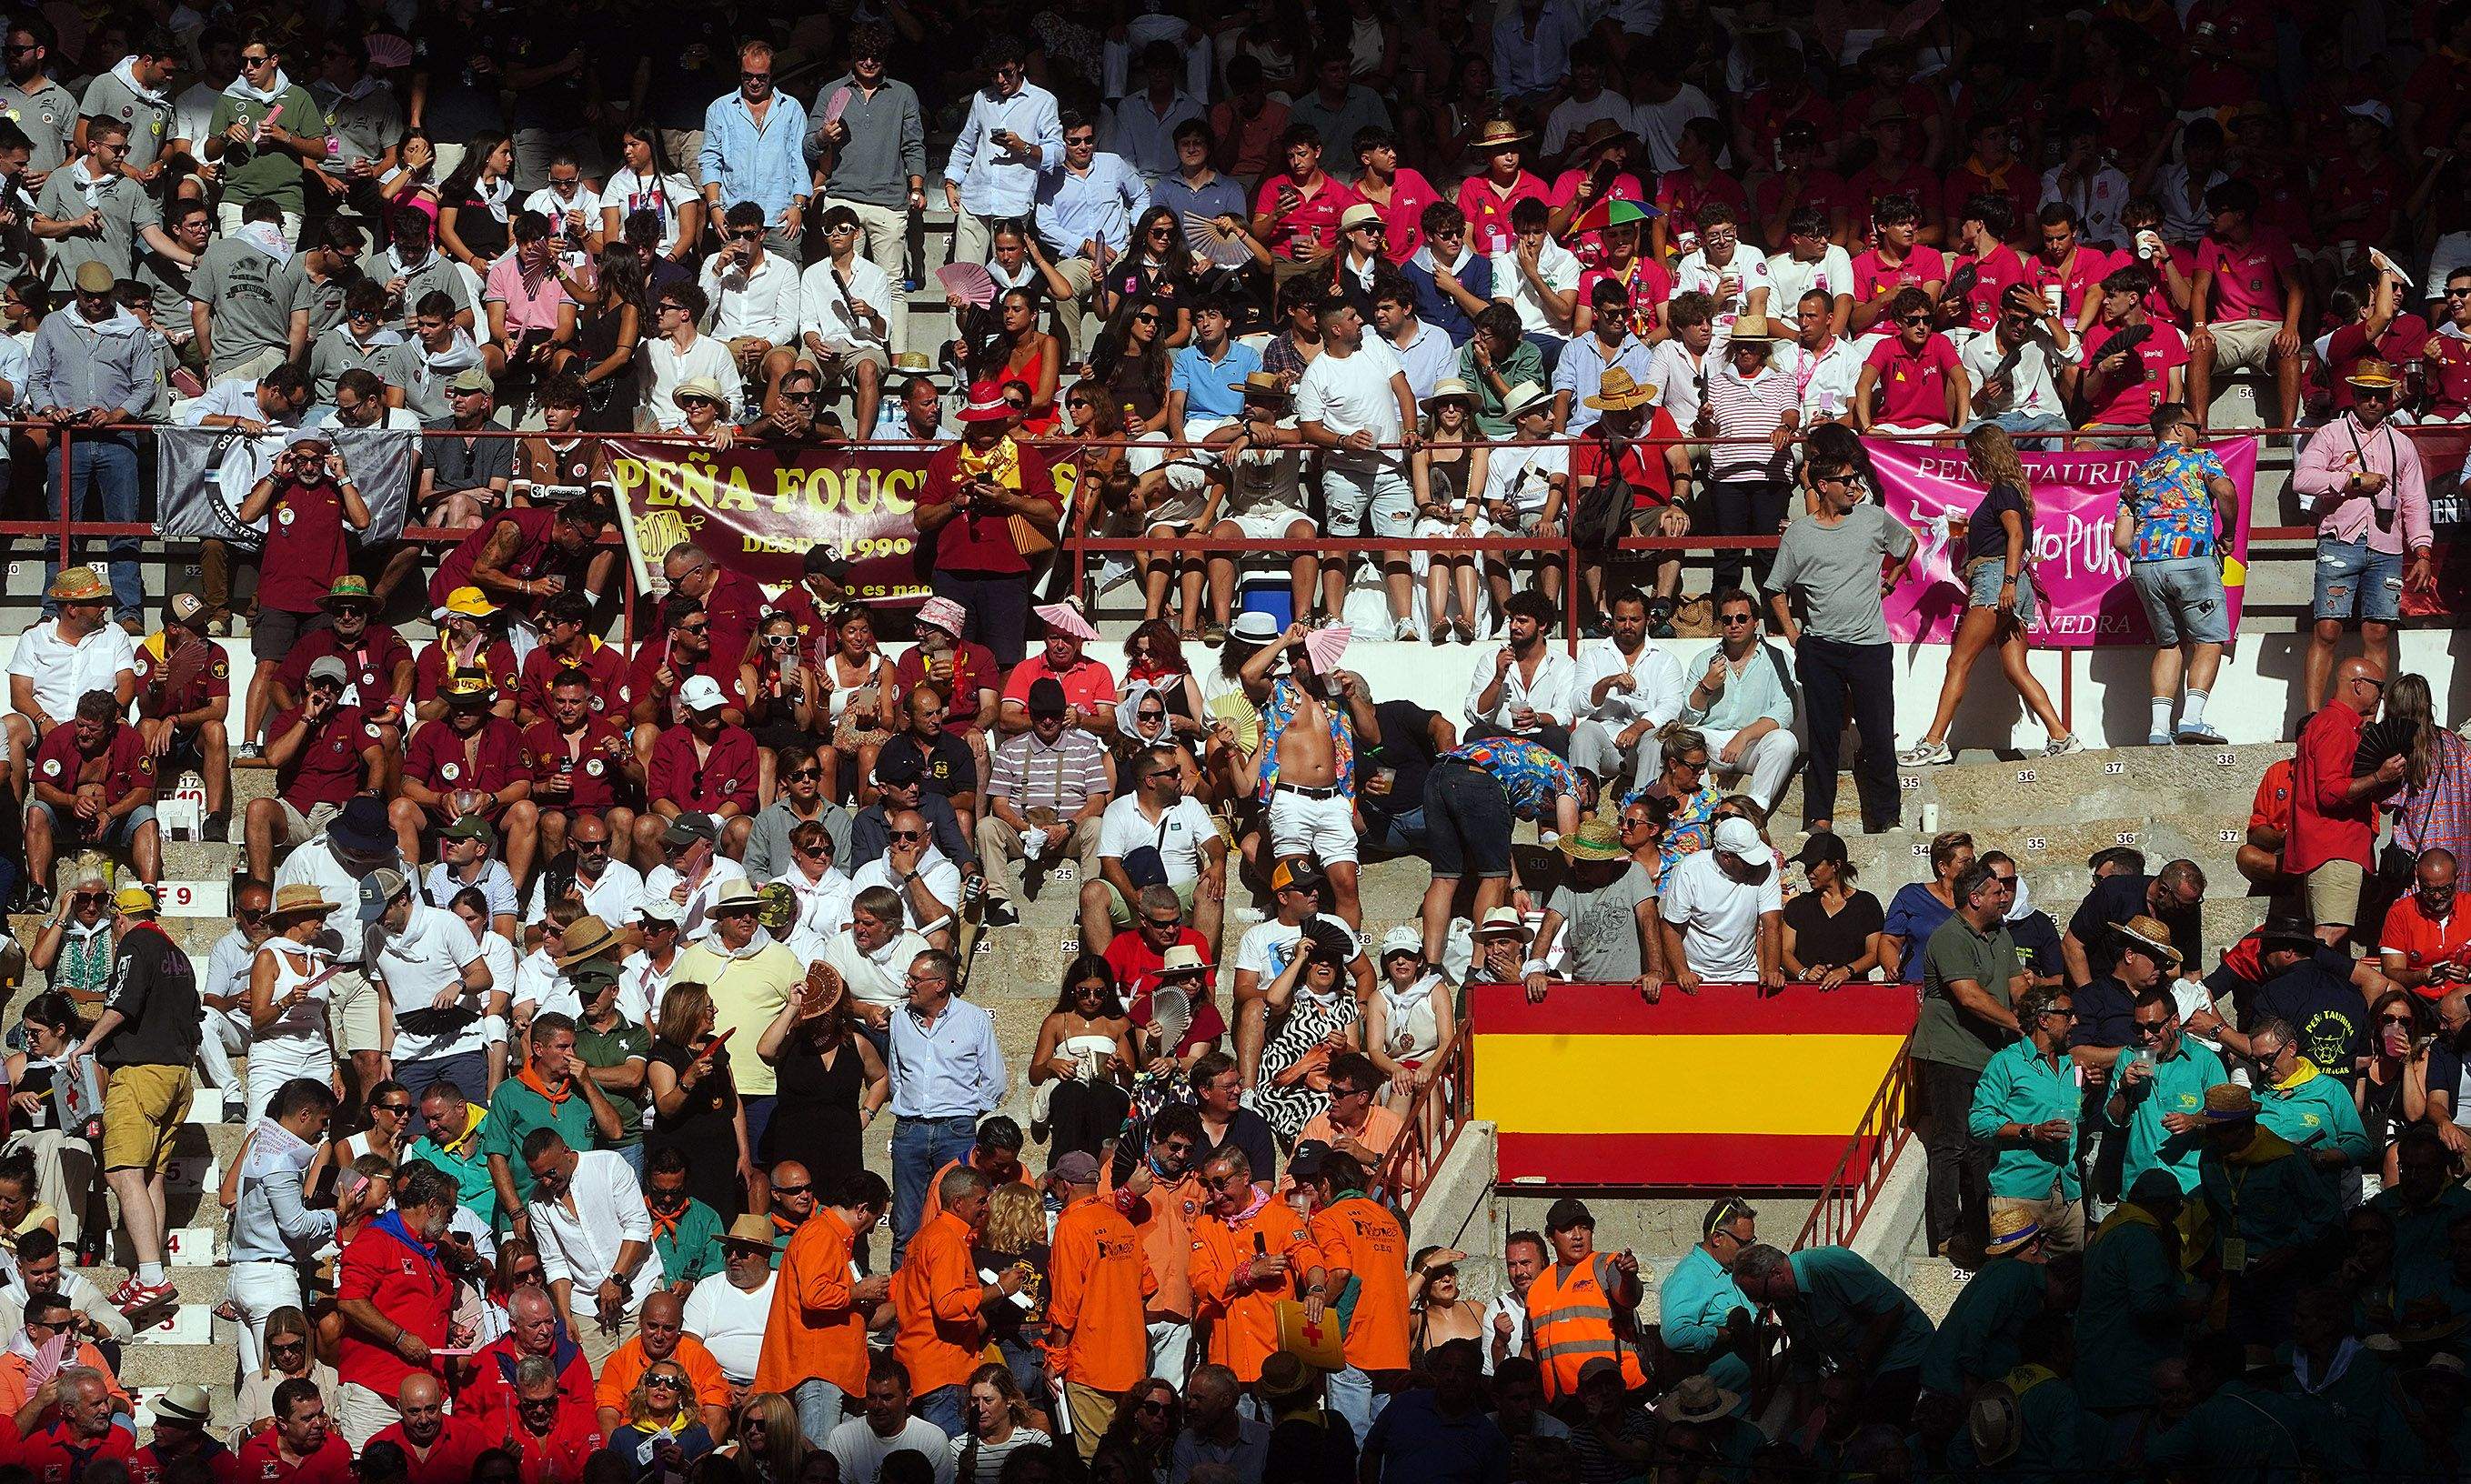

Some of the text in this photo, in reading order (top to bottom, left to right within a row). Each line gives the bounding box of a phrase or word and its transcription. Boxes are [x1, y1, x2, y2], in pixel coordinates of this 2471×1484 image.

[2239, 388, 2255, 398] 56
[2030, 459, 2141, 486] TAURIN
[613, 451, 759, 512] PEÑA
[741, 534, 912, 558] DESD 1990
[3, 564, 18, 574] 30
[92, 562, 107, 573] 31
[186, 566, 202, 577] 32
[2218, 754, 2235, 765] 38
[2105, 762, 2122, 773] 37
[2018, 770, 2035, 782] 36
[182, 777, 198, 787] 17
[1903, 777, 1919, 788] 35
[2117, 833, 2135, 844] 36
[2220, 830, 2237, 840] 37
[2028, 837, 2045, 848] 35
[1914, 844, 1930, 856] 34
[1056, 869, 1072, 879] 25
[177, 887, 192, 906] 9
[1357, 934, 1371, 944] 28
[975, 942, 990, 952] 24
[1062, 941, 1079, 951] 25
[2323, 1009, 2355, 1038] TAURINA
[166, 1162, 182, 1181] 5
[166, 1234, 181, 1254] 4
[1953, 1269, 1971, 1281] 25
[158, 1311, 176, 1331] 3
